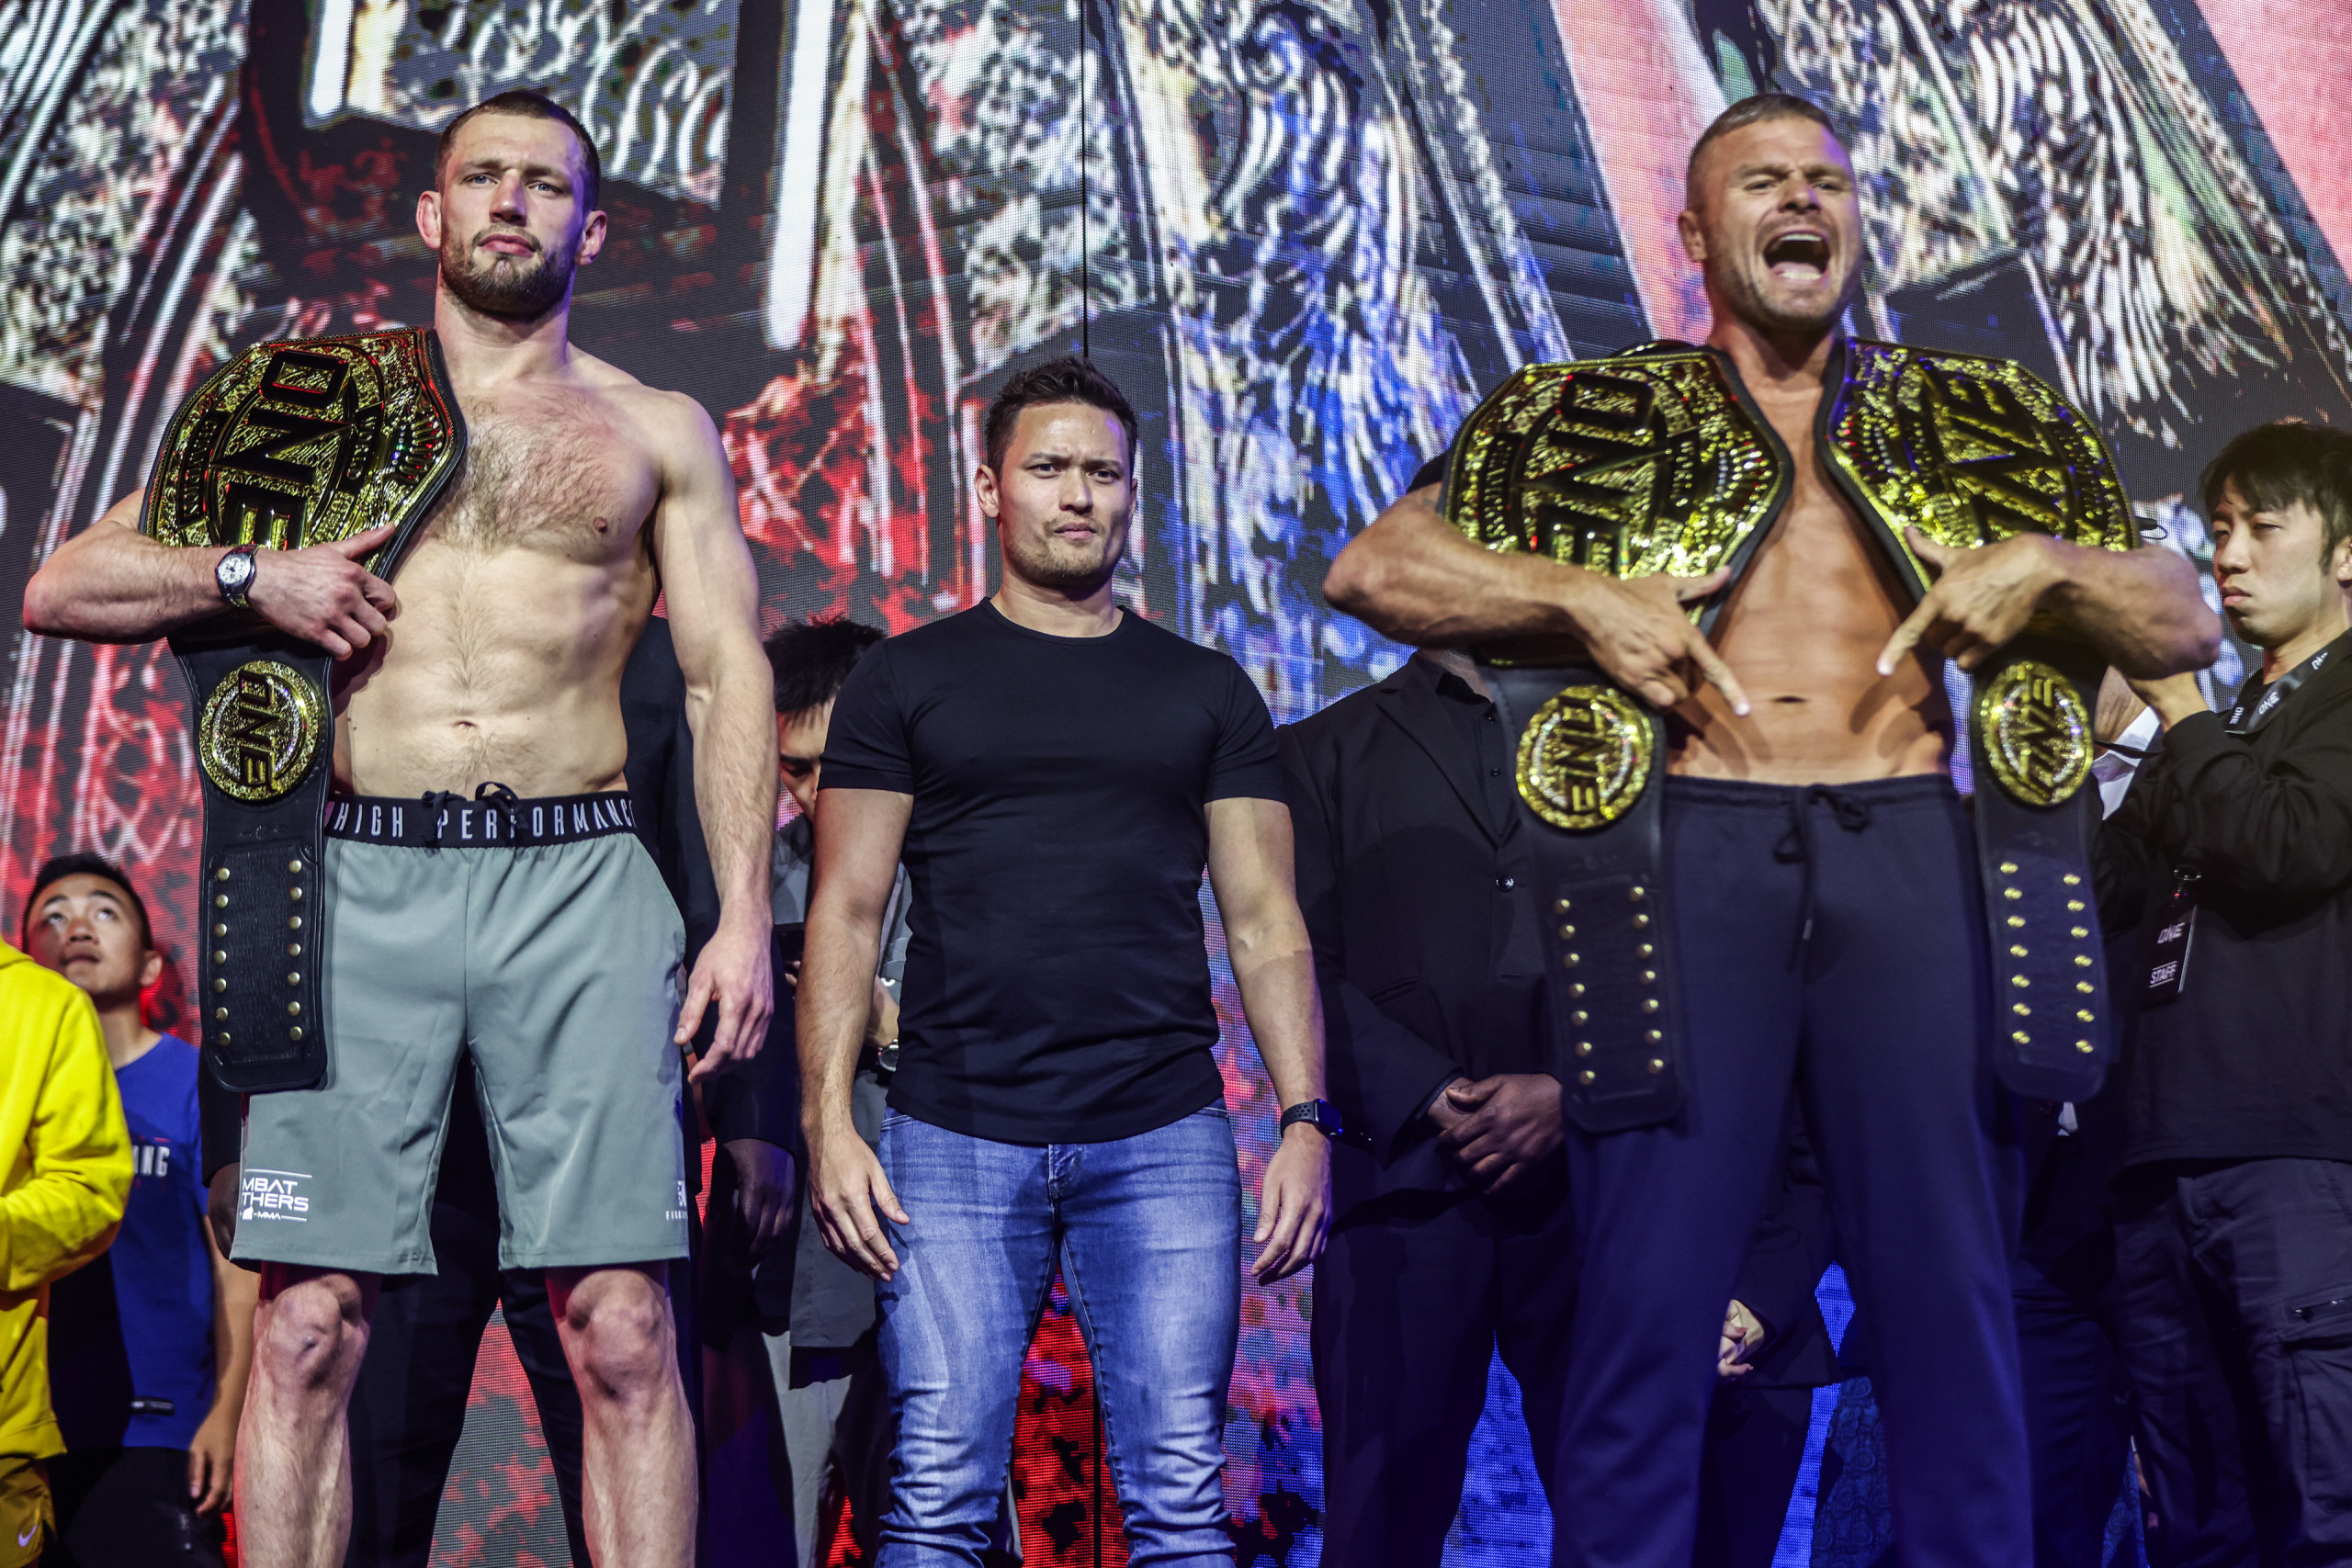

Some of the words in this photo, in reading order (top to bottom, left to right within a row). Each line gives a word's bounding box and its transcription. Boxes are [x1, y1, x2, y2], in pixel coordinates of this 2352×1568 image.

[210, 349, 352, 550] ONE
[1517, 373, 1671, 578] ONE
[2258, 691, 2280, 715] ONE
[2229, 706, 2245, 725] ONE
[231, 668, 277, 789] ONE
[1555, 697, 1606, 812] ONE
[334, 802, 403, 839] HIGH
[436, 798, 637, 840] PERORMANC
[2157, 921, 2186, 944] ONE
[2150, 964, 2177, 985] STAFF
[243, 1178, 298, 1195] MBAT
[243, 1192, 309, 1212] THERS
[257, 1212, 281, 1221] MMA
